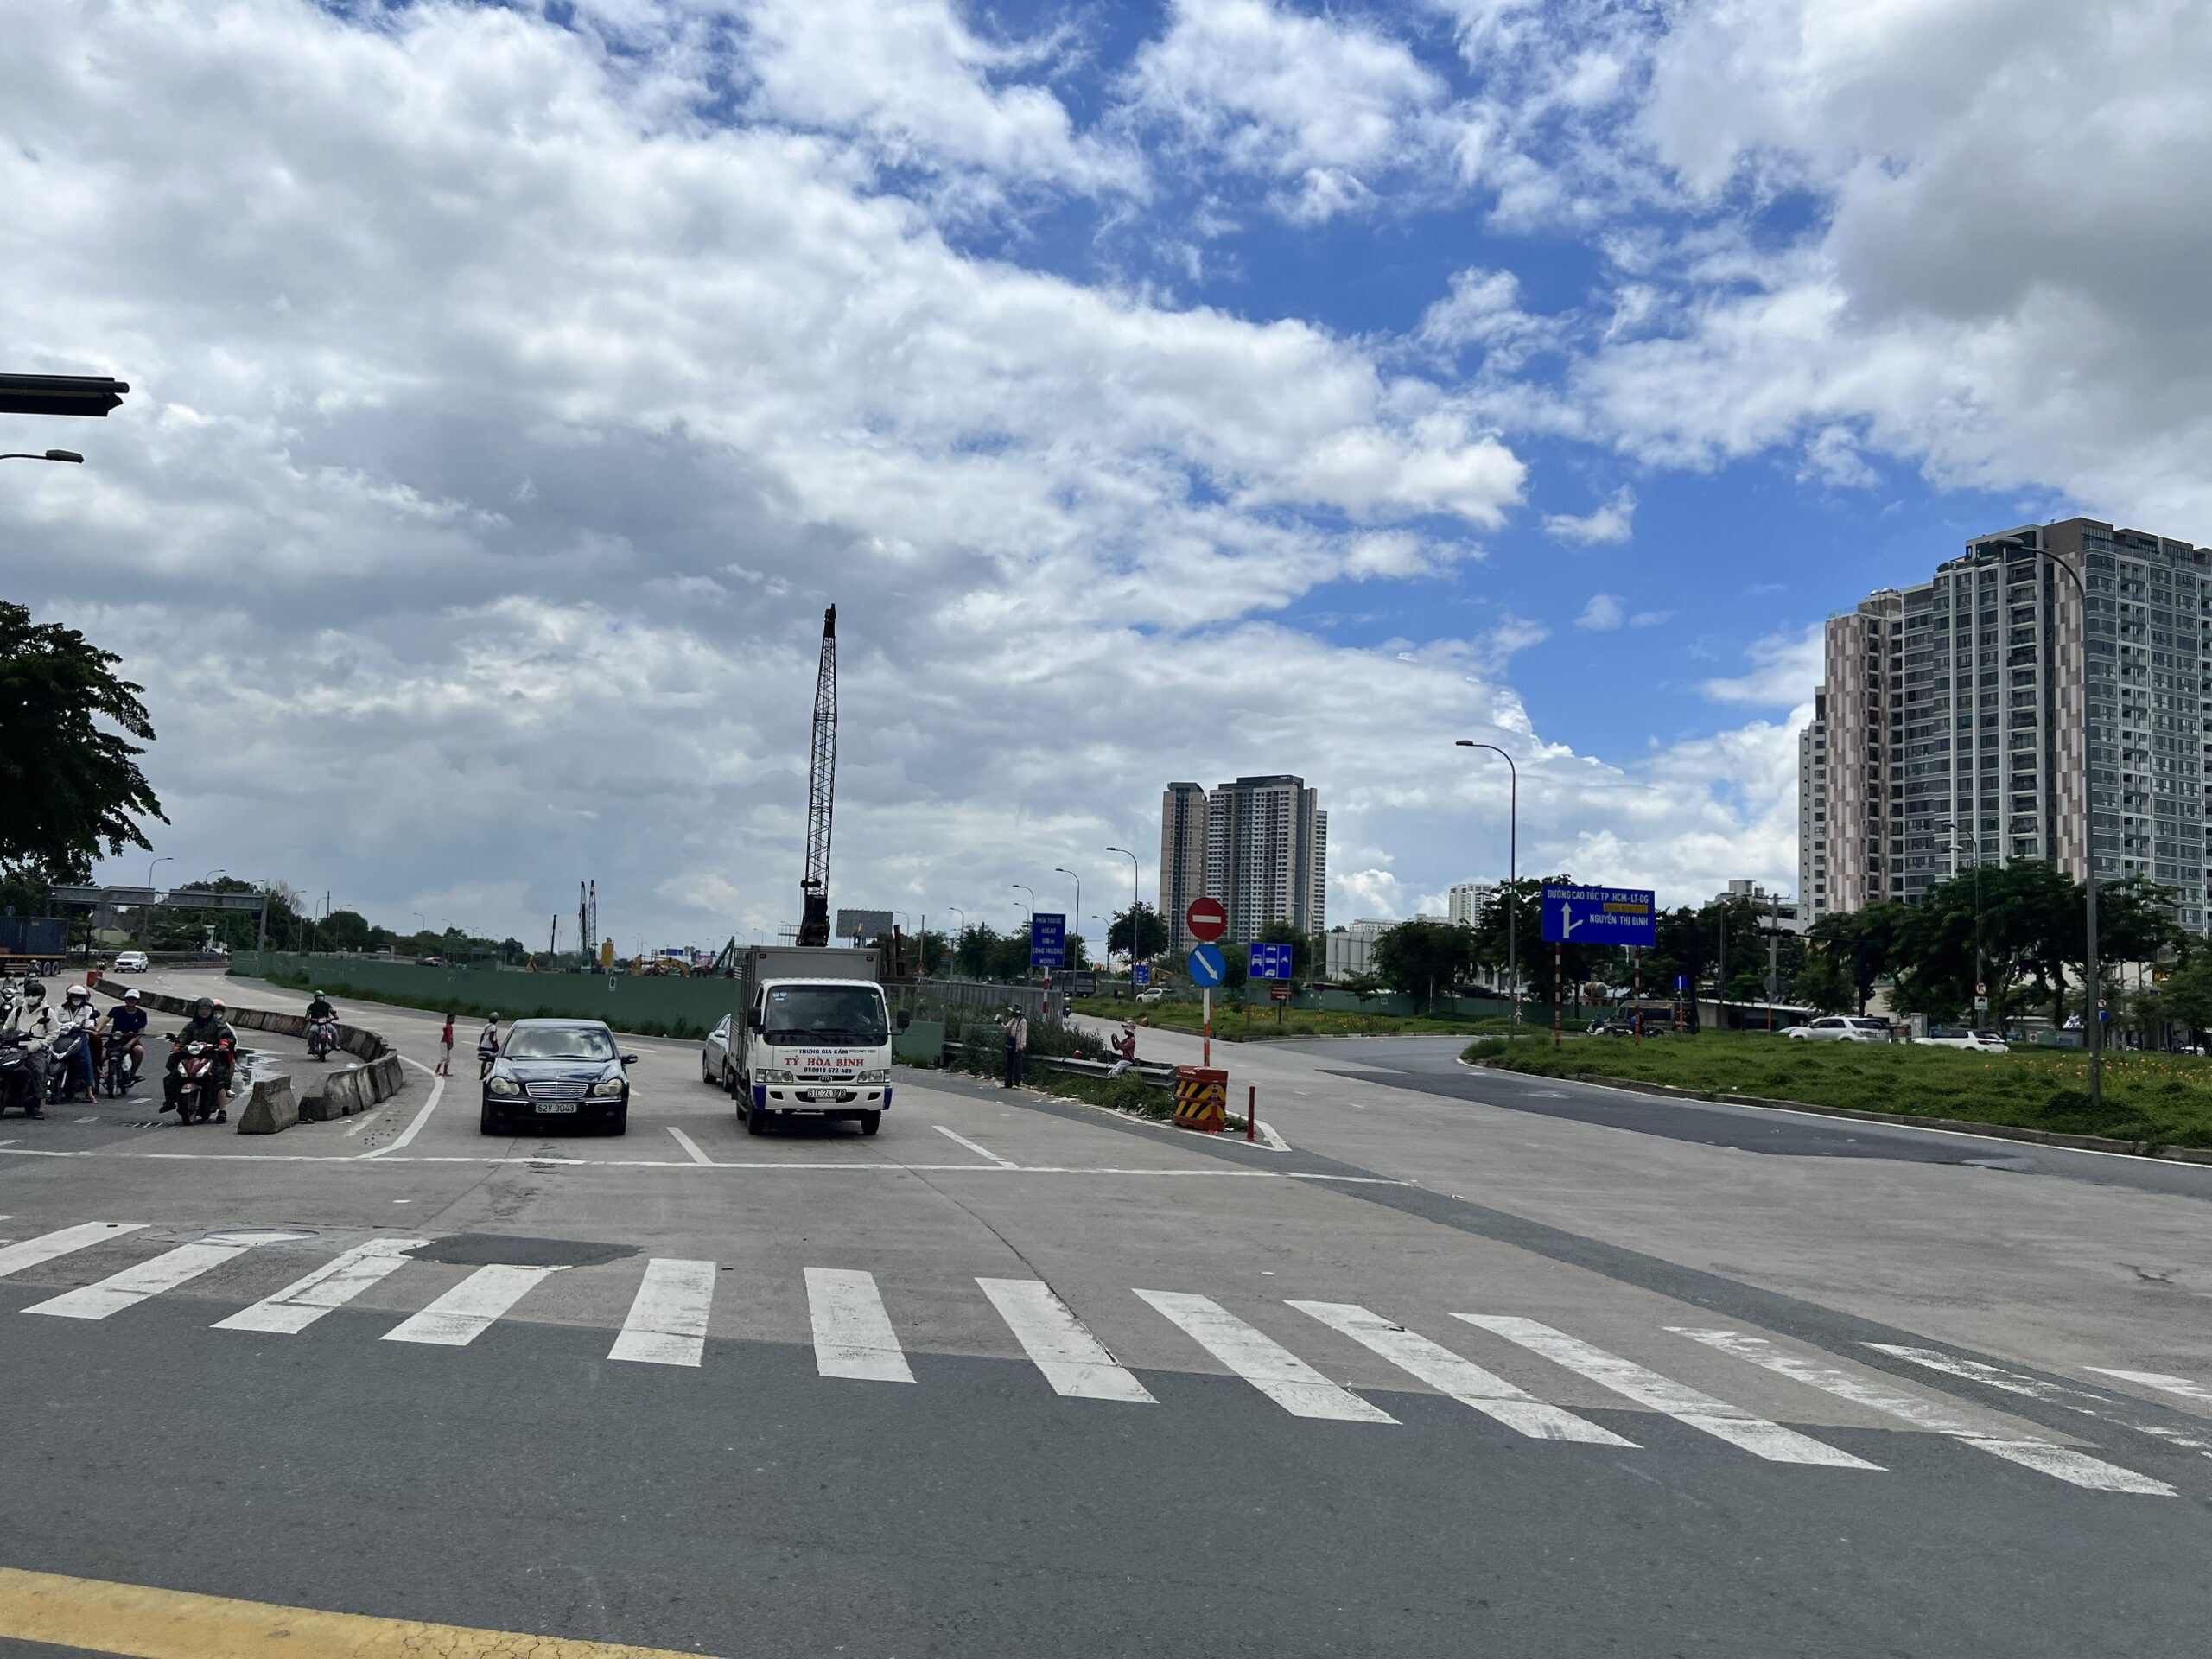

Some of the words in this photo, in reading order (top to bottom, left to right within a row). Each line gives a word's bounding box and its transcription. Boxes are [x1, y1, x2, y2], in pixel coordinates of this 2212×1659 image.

[1573, 891, 1584, 899] CAO
[1620, 916, 1630, 926] THỊ
[807, 1056, 831, 1066] HÒA
[836, 1057, 864, 1067] BÌNH
